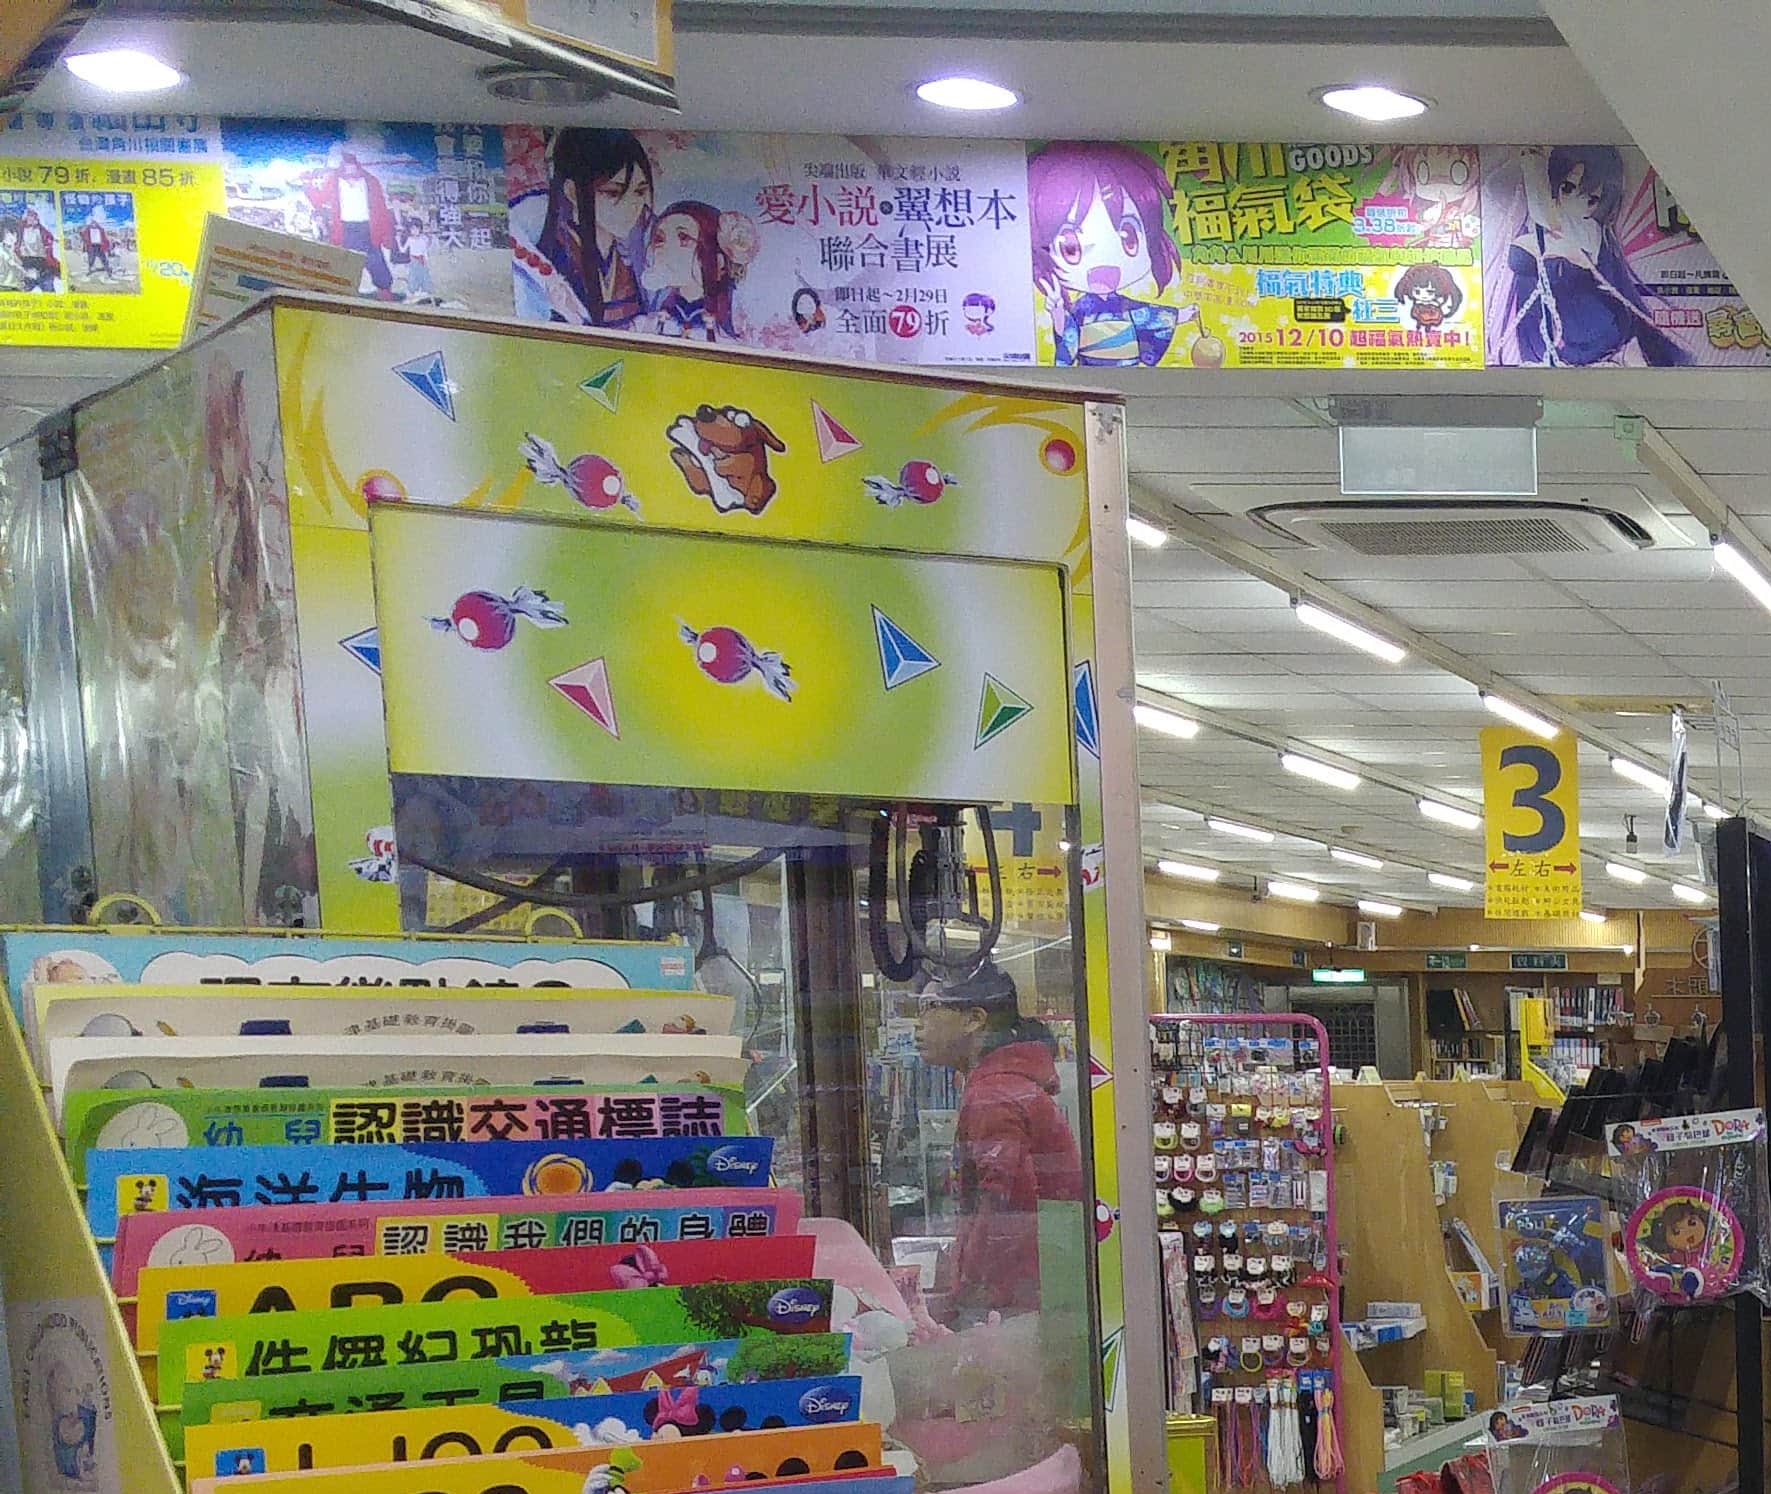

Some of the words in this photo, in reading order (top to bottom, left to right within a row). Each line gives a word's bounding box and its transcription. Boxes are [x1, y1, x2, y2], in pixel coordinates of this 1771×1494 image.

[1288, 144, 1375, 172] GOODS
[755, 183, 879, 226] 愛小說
[1170, 175, 1359, 246] 福氣袋
[818, 232, 960, 273] 聯合書展
[1256, 269, 1366, 299] 福氣特典
[835, 304, 951, 339] 全面79折
[1238, 330, 1276, 345] 2015
[1276, 327, 1345, 349] 12/10
[1499, 744, 1567, 855] 3
[1508, 857, 1552, 879] 左右
[333, 1095, 726, 1145] 認識交通標誌
[380, 1206, 773, 1258] 認識我們的身體
